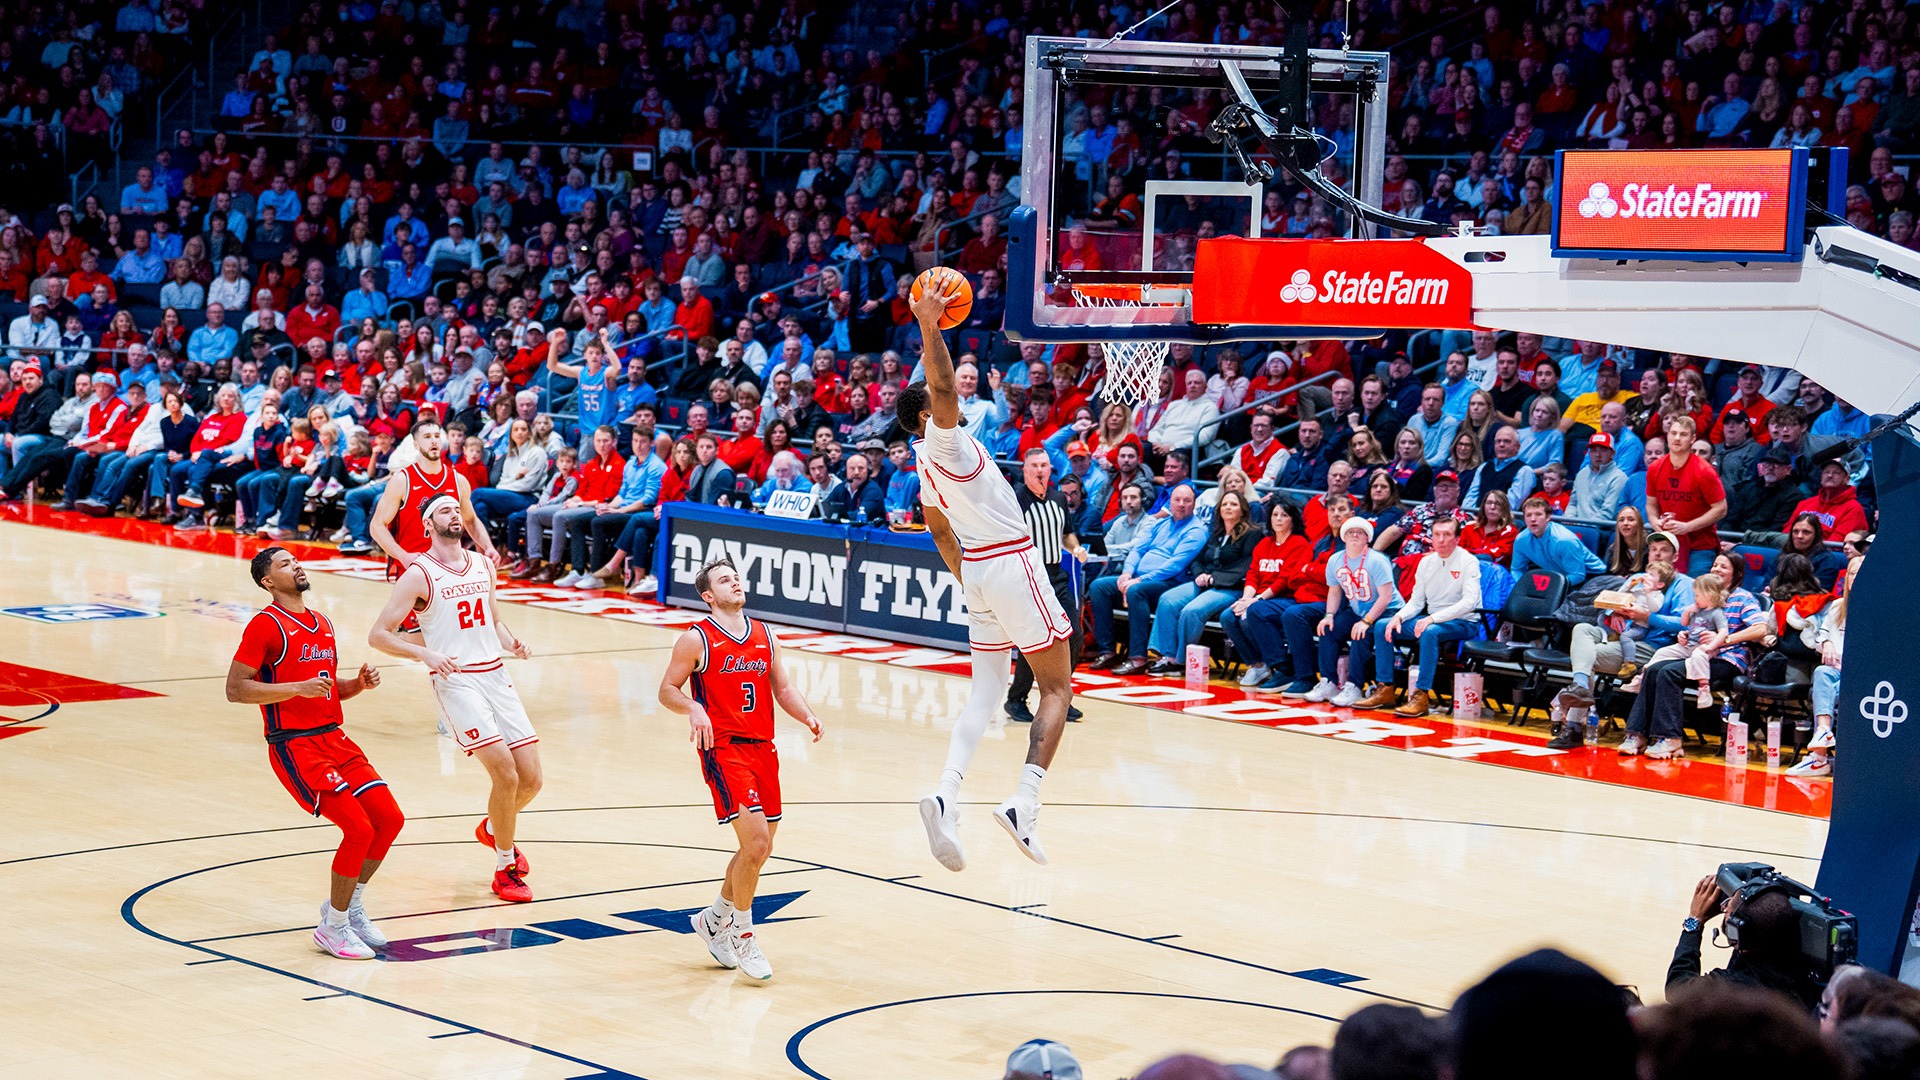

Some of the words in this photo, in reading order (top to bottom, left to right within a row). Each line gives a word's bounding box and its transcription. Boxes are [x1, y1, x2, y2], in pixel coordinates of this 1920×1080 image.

[773, 493, 811, 512] WHIO
[441, 581, 489, 600] DAYTON
[457, 598, 486, 630] 24
[720, 655, 768, 677] Liberty
[741, 682, 756, 713] 3
